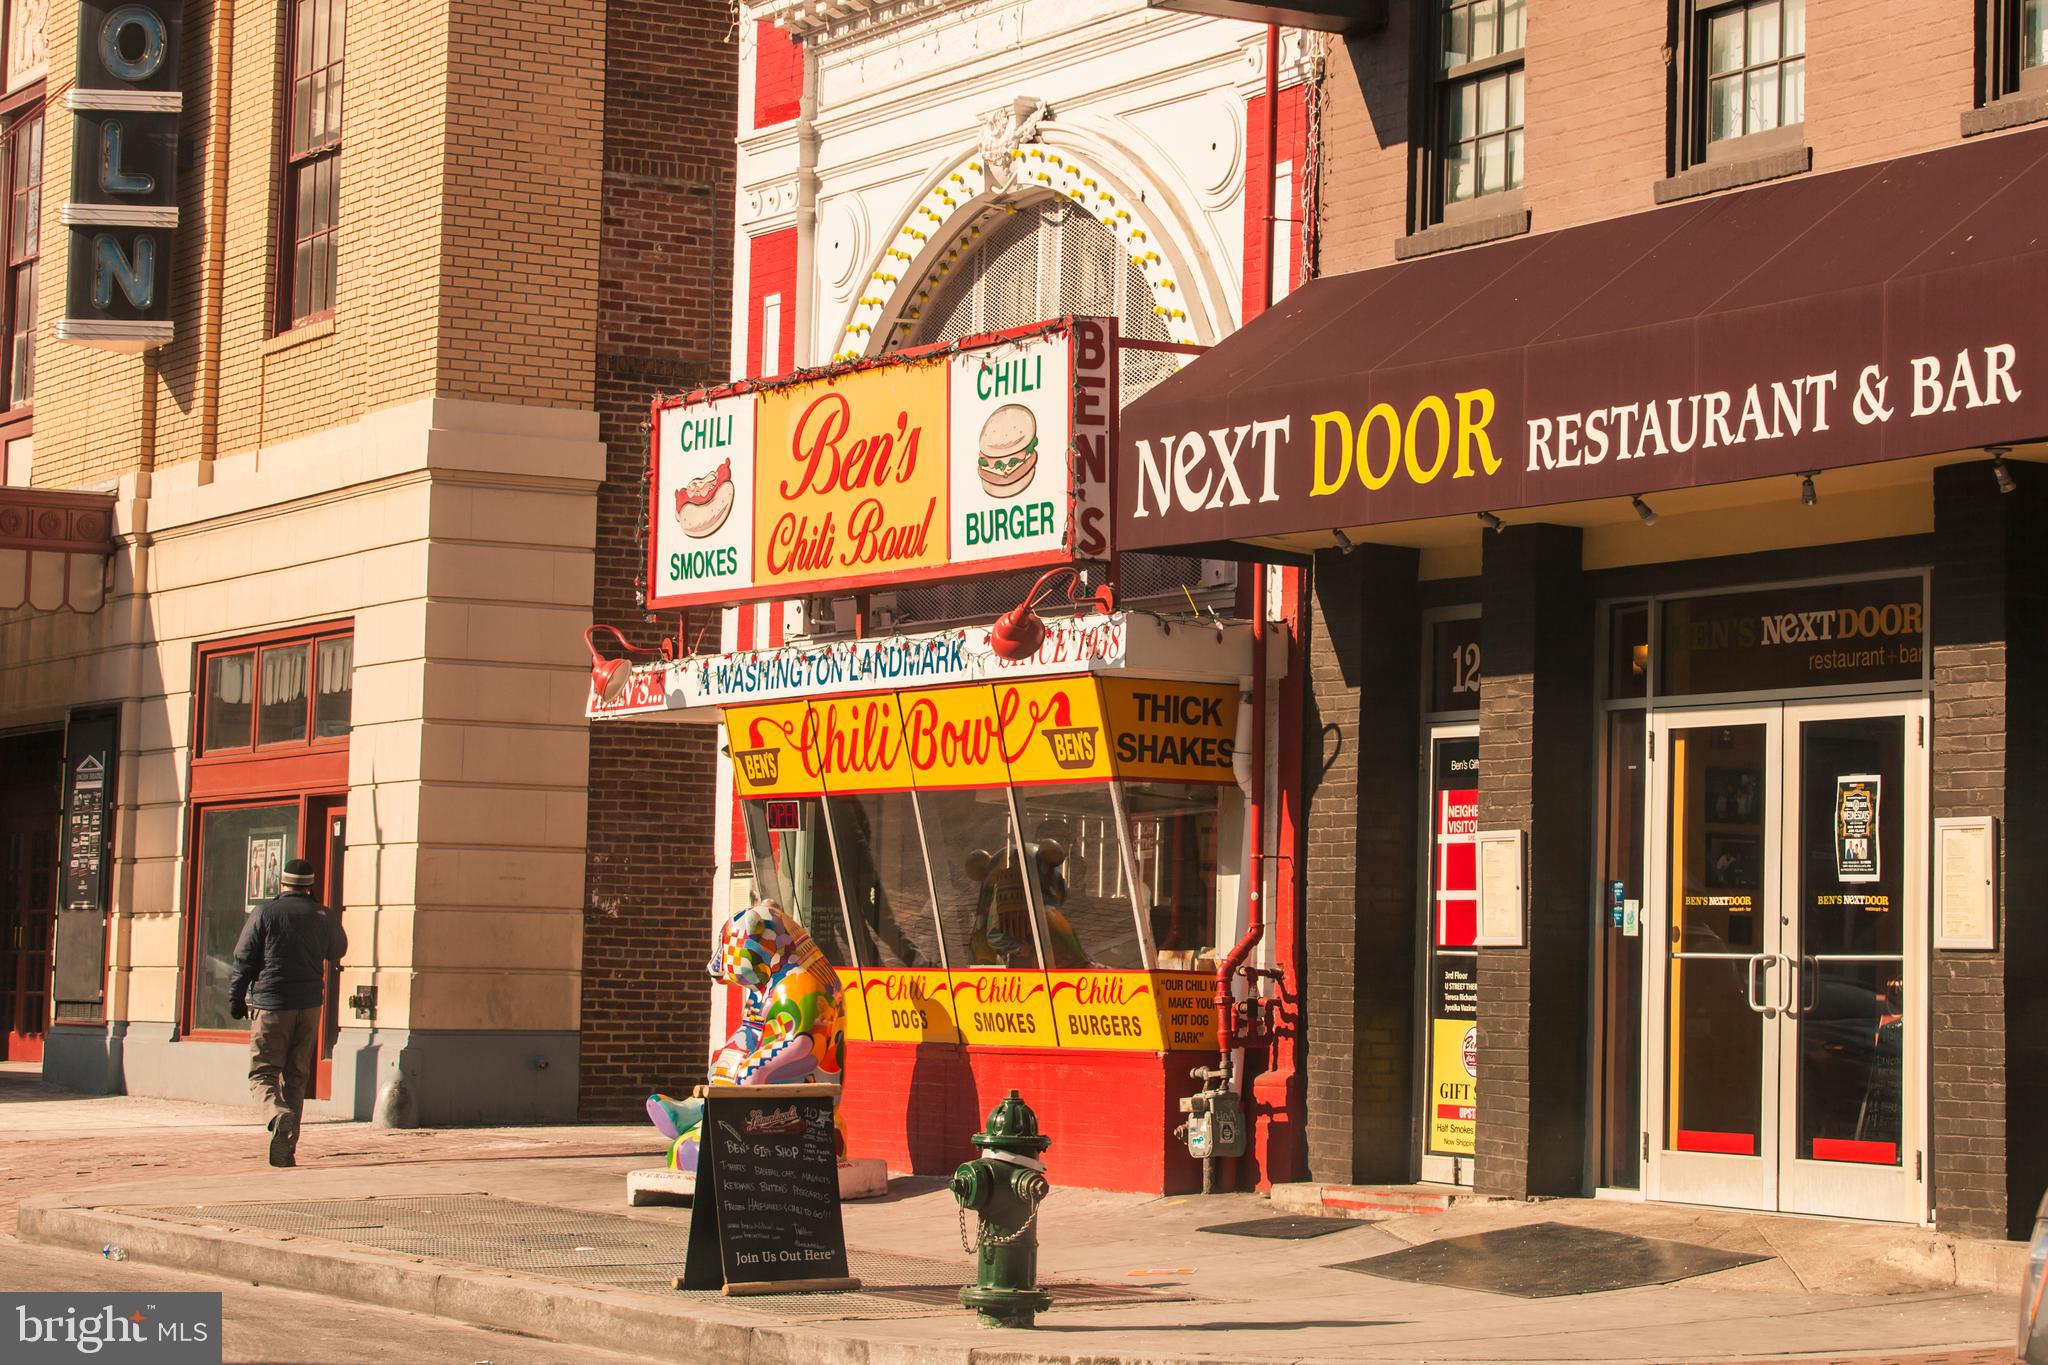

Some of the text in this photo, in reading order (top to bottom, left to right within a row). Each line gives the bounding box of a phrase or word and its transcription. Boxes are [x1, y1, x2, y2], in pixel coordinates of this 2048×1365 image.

[977, 354, 1042, 400] CHILI
[680, 414, 734, 453] CHILI
[1309, 388, 1503, 498] DOOR
[1526, 370, 1837, 471] RESTAURANT
[1852, 363, 1895, 425] &
[1910, 343, 2023, 417] BAR
[779, 392, 922, 500] Ben's
[767, 497, 937, 575] Chili Bowl
[966, 501, 1055, 545] BURGER
[670, 546, 737, 581] SMOKES
[717, 654, 843, 694] WASHINGTON
[850, 639, 966, 681] LANDMARK
[1808, 646, 1885, 671] restaurant
[1132, 692, 1223, 727] THICK
[800, 687, 1030, 779] Chili Bowl
[1053, 730, 1095, 762] BEN'S
[1116, 732, 1235, 769] SHAKES
[744, 752, 778, 780] BEN'S
[770, 803, 798, 828] OPEN
[1449, 820, 1478, 833] VISITO
[1817, 895, 1843, 905] BEN'S
[885, 974, 930, 1001] Chili
[975, 975, 1026, 1005] Chili
[1074, 975, 1126, 1005] Chili
[1168, 997, 1193, 1009] MAKE
[891, 1009, 928, 1029] DOGS
[973, 1011, 1036, 1034] SMOKES
[1068, 1014, 1142, 1037] BURGERS
[1171, 1014, 1209, 1026] HOT DOG
[1440, 1082, 1470, 1100] GIFT
[1437, 1124, 1474, 1135] Half Smokes
[775, 1144, 799, 1158] SHOP
[735, 1251, 759, 1266] Join
[762, 1250, 777, 1262] Us
[779, 1250, 802, 1262] Out
